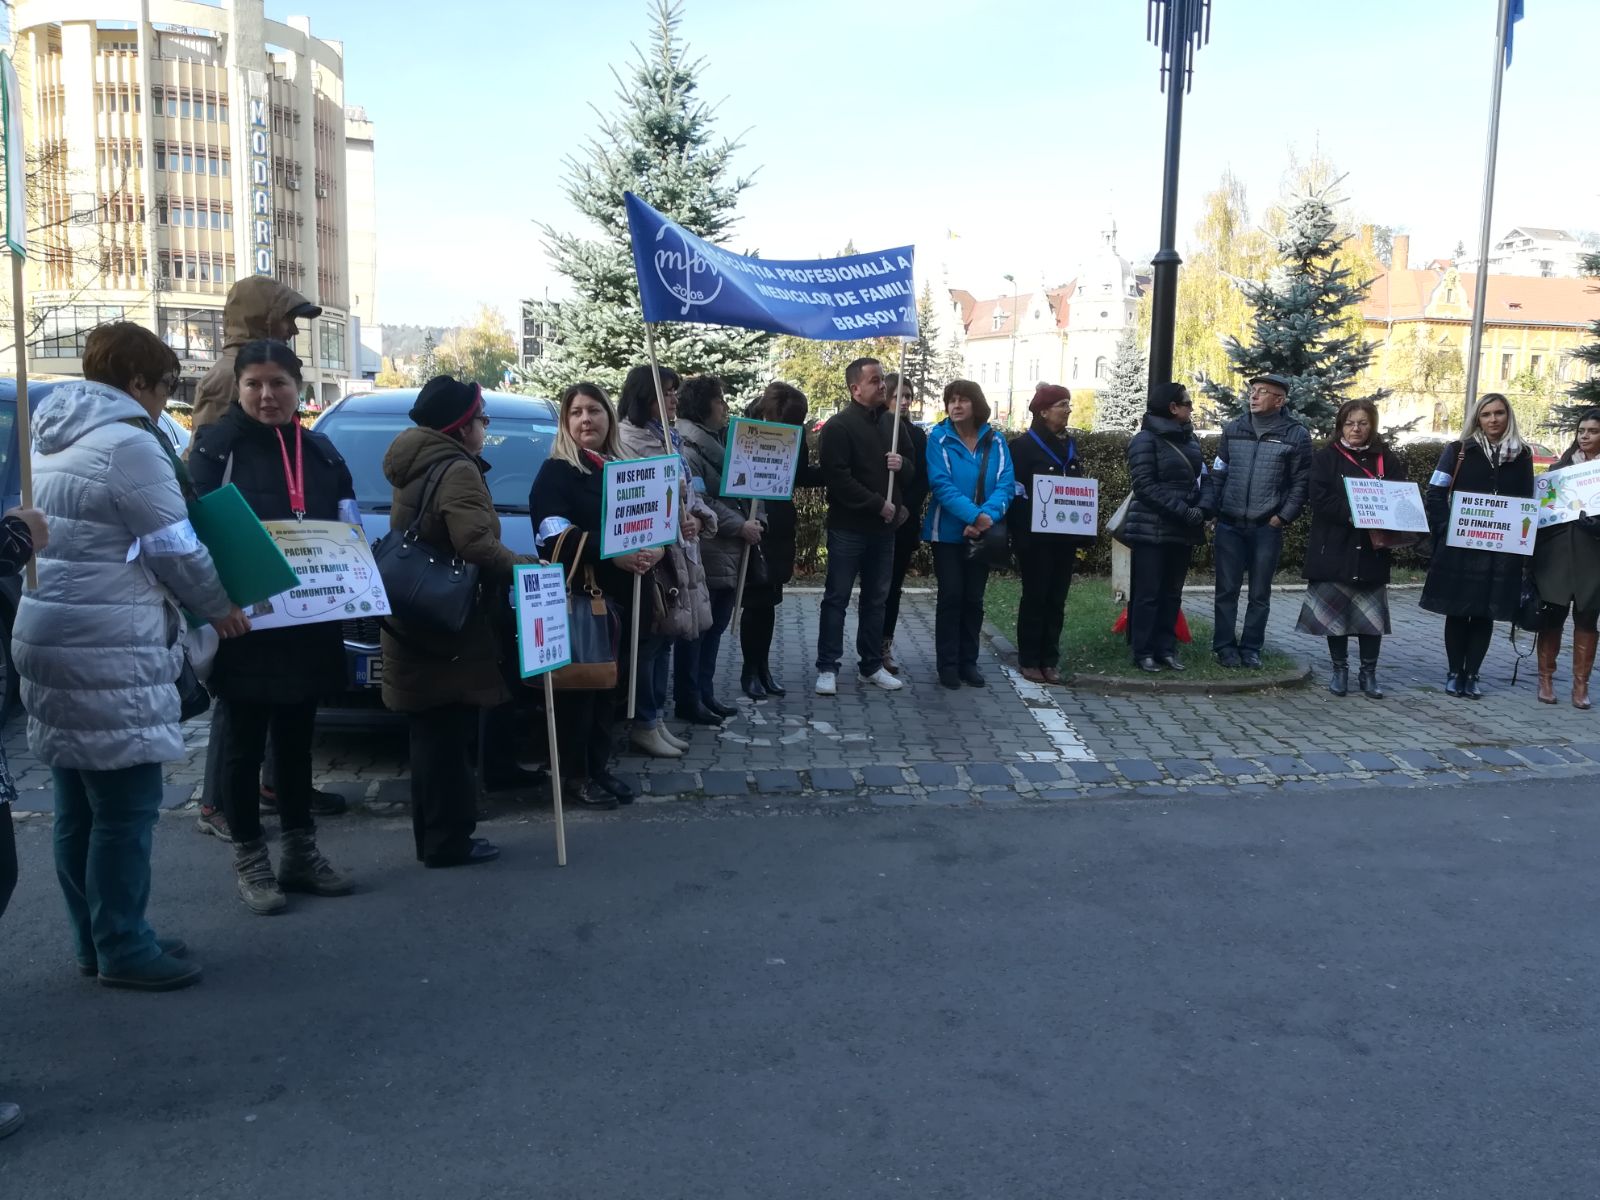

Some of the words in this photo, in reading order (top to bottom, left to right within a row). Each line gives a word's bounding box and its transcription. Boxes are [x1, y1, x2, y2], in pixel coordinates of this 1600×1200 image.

[775, 256, 896, 284] PROFESIONALĂ
[897, 255, 911, 269] A
[755, 282, 836, 307] MEDICILOR
[834, 291, 860, 307] DE
[859, 279, 914, 303] FAMILI
[832, 309, 898, 330] BRAȘOV
[616, 471, 626, 484] NU
[627, 470, 636, 482] SE
[636, 467, 656, 481] POATE
[664, 465, 676, 479] 10%
[616, 485, 645, 502] CALITATE
[1054, 485, 1064, 495] NU
[1462, 496, 1473, 505] NU
[1474, 498, 1484, 506] SE
[1485, 498, 1509, 508] POATE
[1520, 503, 1538, 512] 10%
[615, 506, 625, 520] CU
[626, 500, 659, 517] FINANTARE
[1460, 507, 1495, 518] CALITATE
[614, 523, 622, 537] LA
[623, 517, 654, 535] JUMATATE
[1458, 518, 1469, 526] CU
[1470, 519, 1512, 531] FINANTARE
[1456, 528, 1466, 537] LA
[1467, 529, 1505, 541] JUMATATE
[309, 565, 320, 574] DE
[320, 563, 350, 573] FAMILIE
[523, 573, 541, 593] VREM
[289, 585, 346, 599] COMUNITATEA
[534, 617, 545, 648] NU
